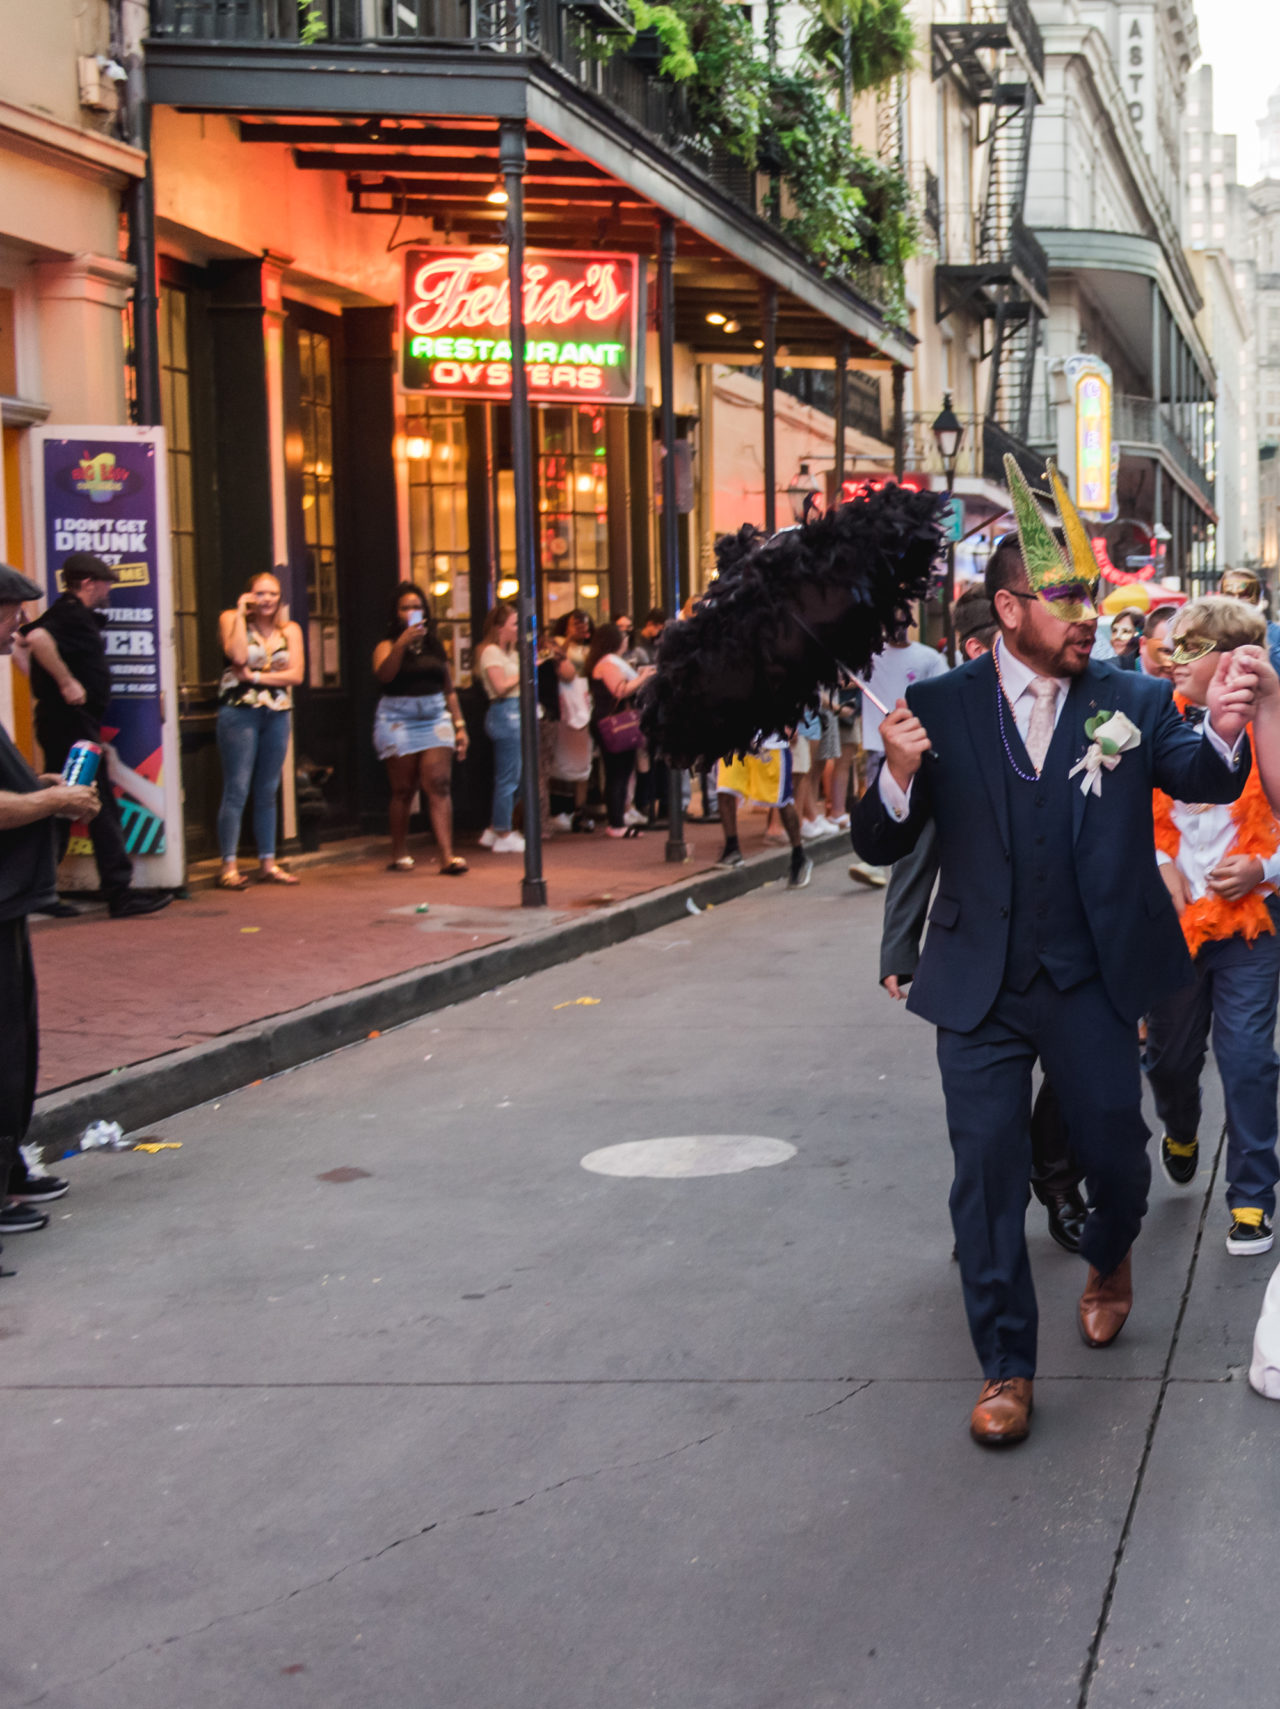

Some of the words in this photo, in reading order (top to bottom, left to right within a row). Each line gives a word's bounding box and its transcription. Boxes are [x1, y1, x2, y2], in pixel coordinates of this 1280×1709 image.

[55, 518, 61, 531] I
[63, 518, 114, 532] DON'T
[115, 519, 148, 532] GET
[55, 532, 148, 552] DRUNK
